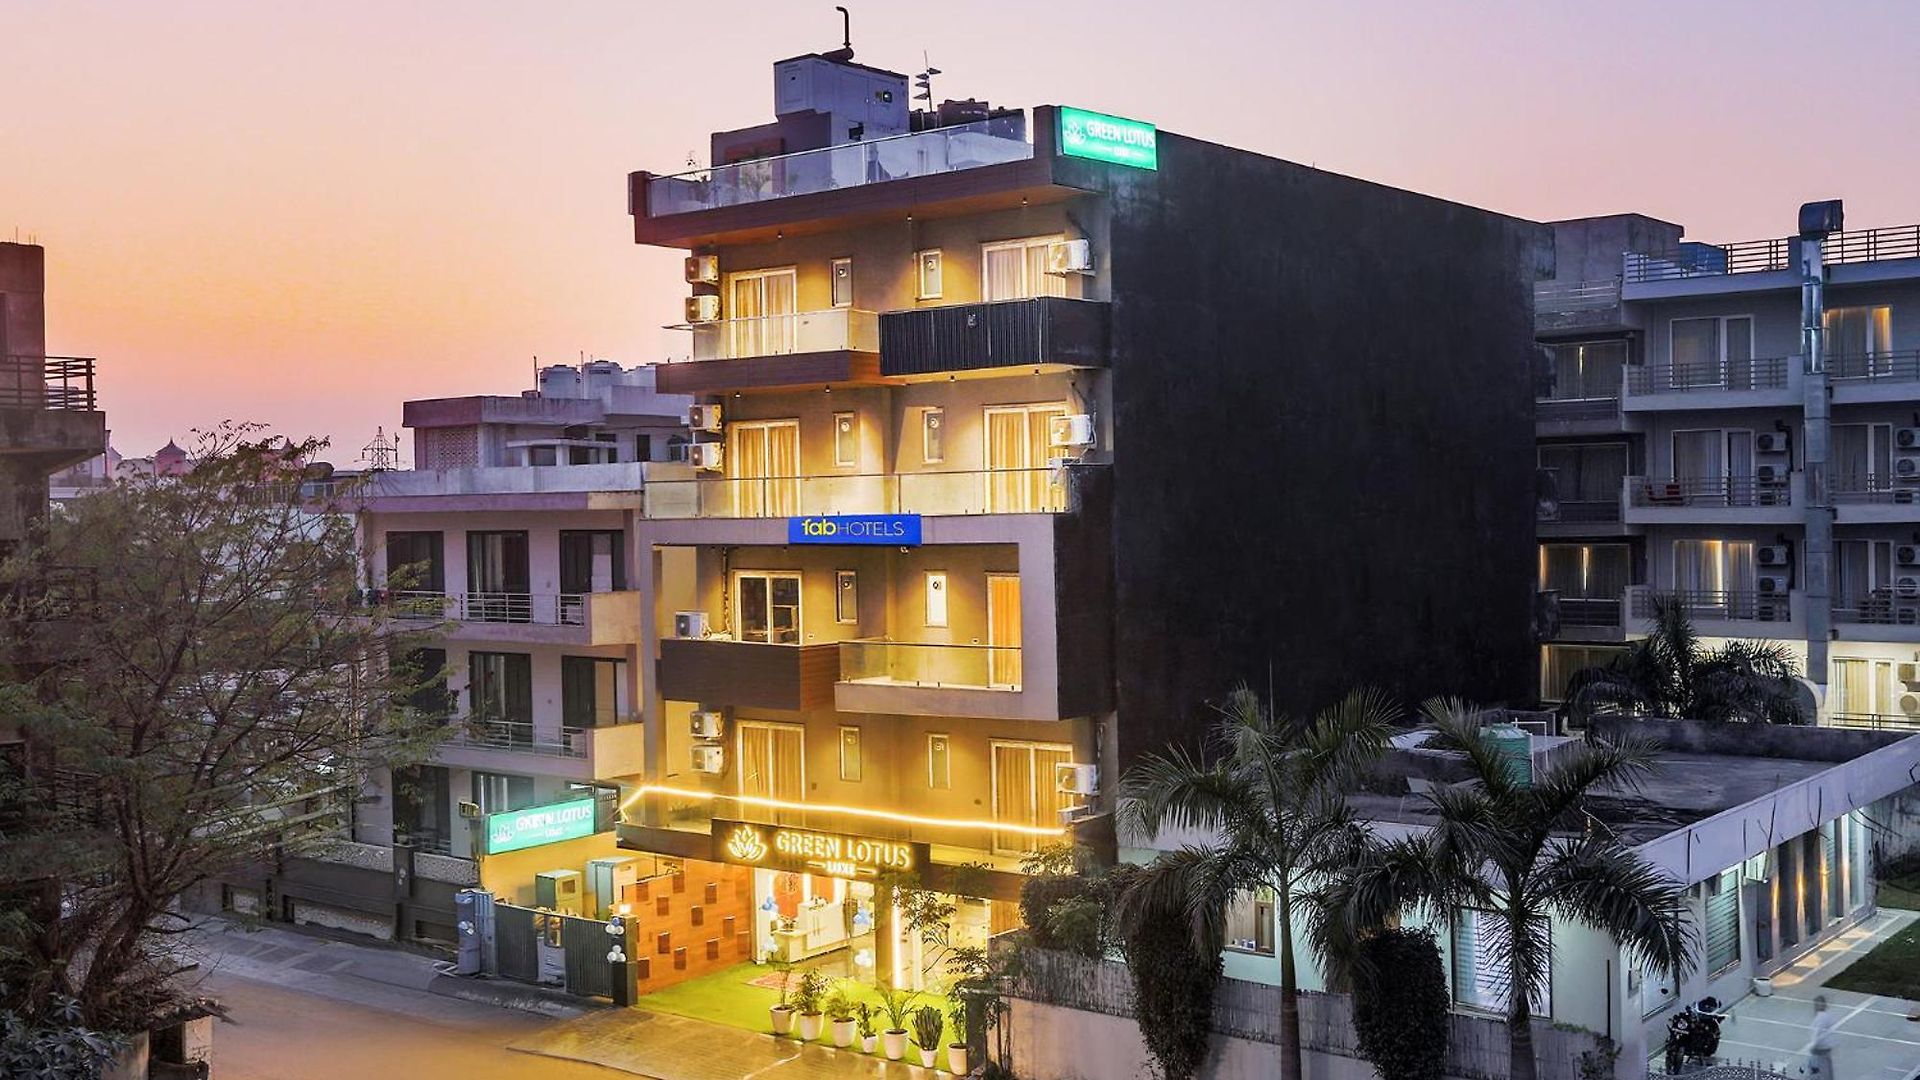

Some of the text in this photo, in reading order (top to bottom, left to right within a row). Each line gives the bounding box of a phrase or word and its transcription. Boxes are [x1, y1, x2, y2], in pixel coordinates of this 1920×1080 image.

[1086, 121, 1155, 148] GREEN LOTUS
[557, 806, 591, 823] LOTUS
[777, 832, 911, 868] GREEN LOTUS
